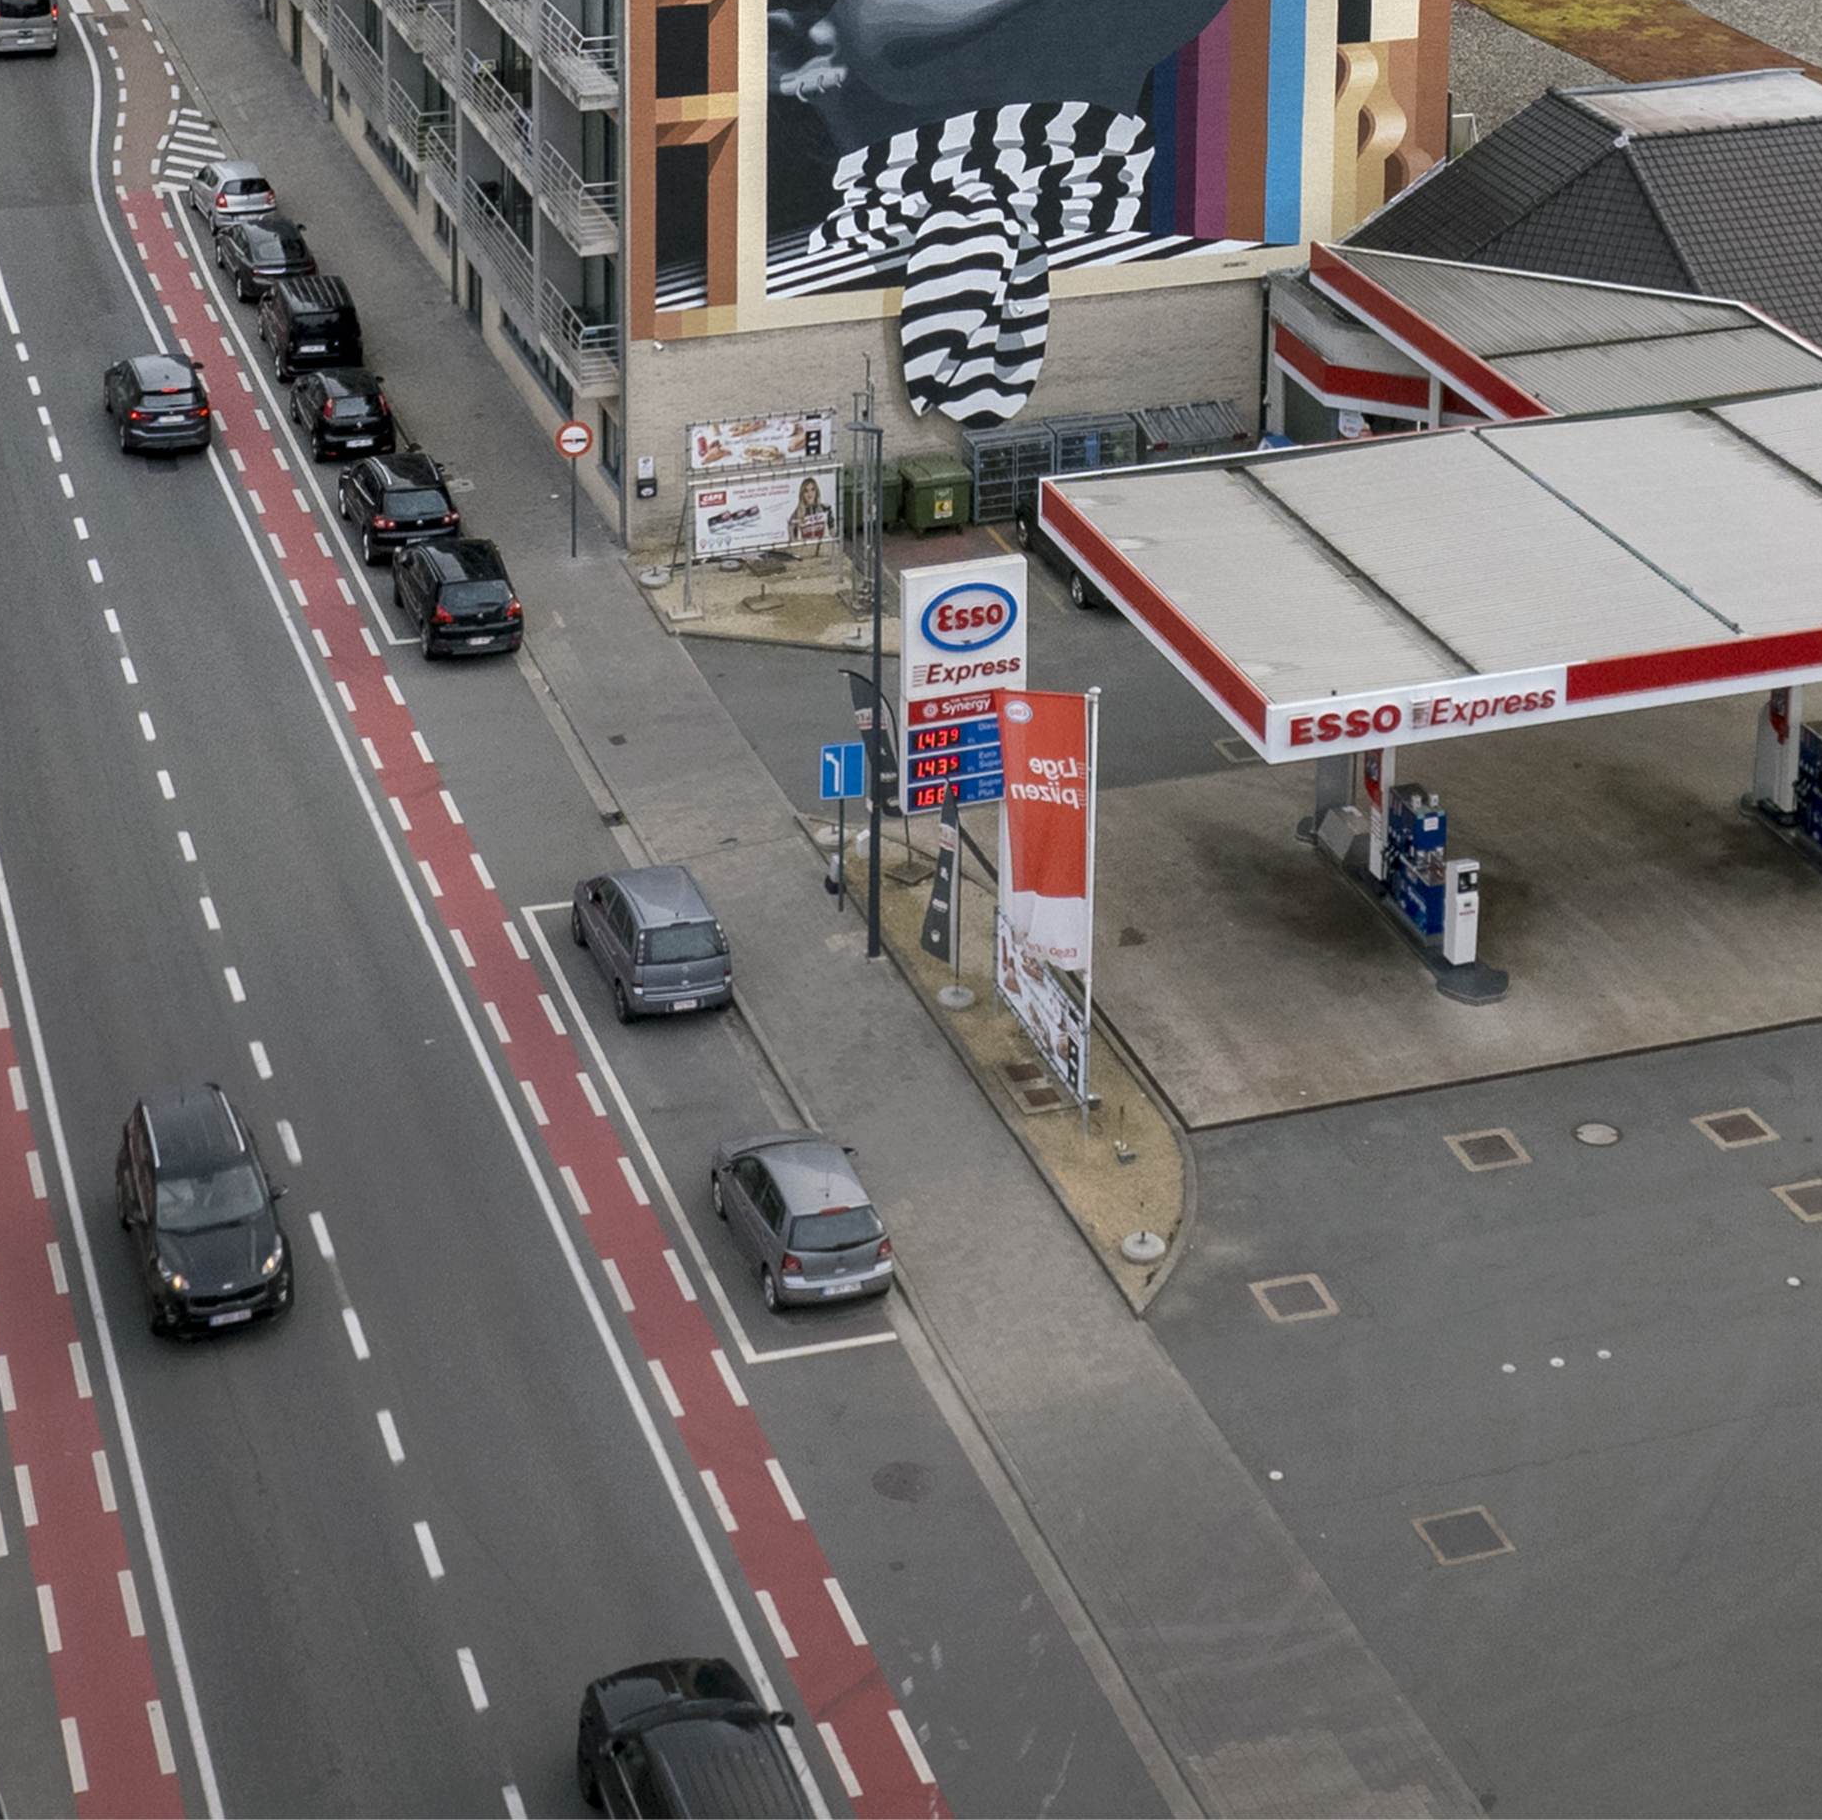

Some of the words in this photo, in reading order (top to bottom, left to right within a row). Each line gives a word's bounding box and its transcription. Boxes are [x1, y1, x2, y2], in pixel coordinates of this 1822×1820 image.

[936, 603, 1005, 633] Esso
[925, 656, 1021, 686] Express
[941, 697, 992, 716] Synergy
[1289, 703, 1402, 747] ESSO
[1429, 687, 1557, 727] Express
